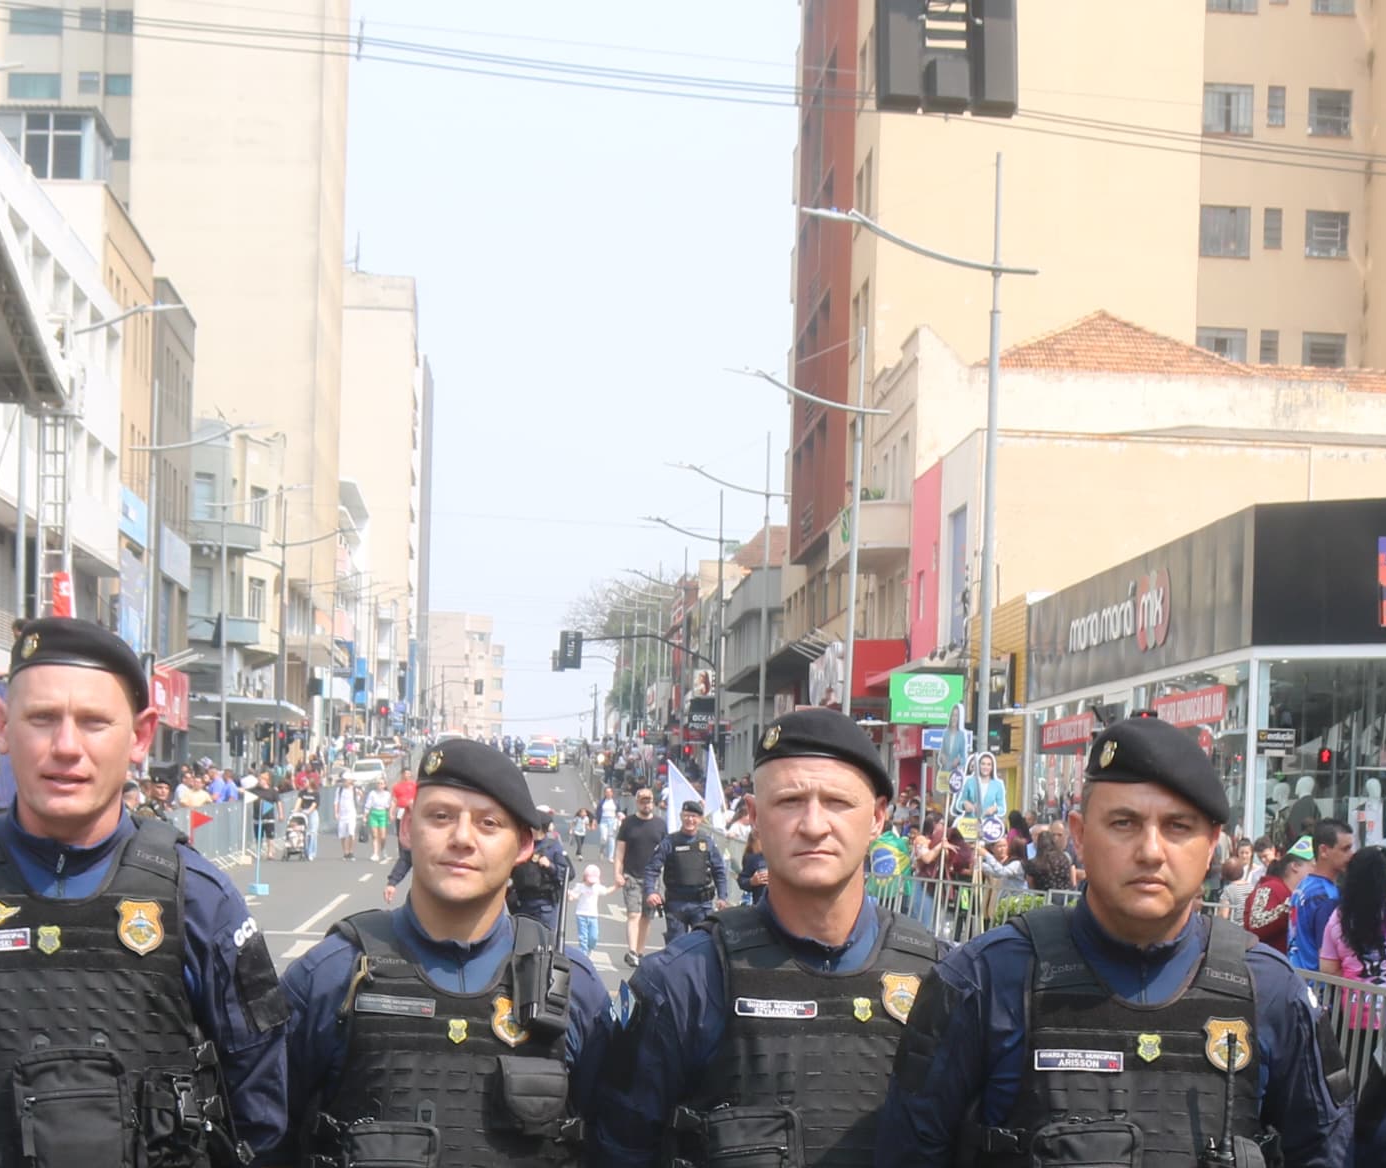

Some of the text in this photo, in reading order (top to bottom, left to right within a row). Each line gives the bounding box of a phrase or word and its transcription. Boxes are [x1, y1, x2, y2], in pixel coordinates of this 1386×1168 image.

[1139, 587, 1163, 633] mix
[949, 774, 962, 789] 45
[982, 821, 1001, 837] 45
[1058, 1058, 1100, 1067] ARISSON
